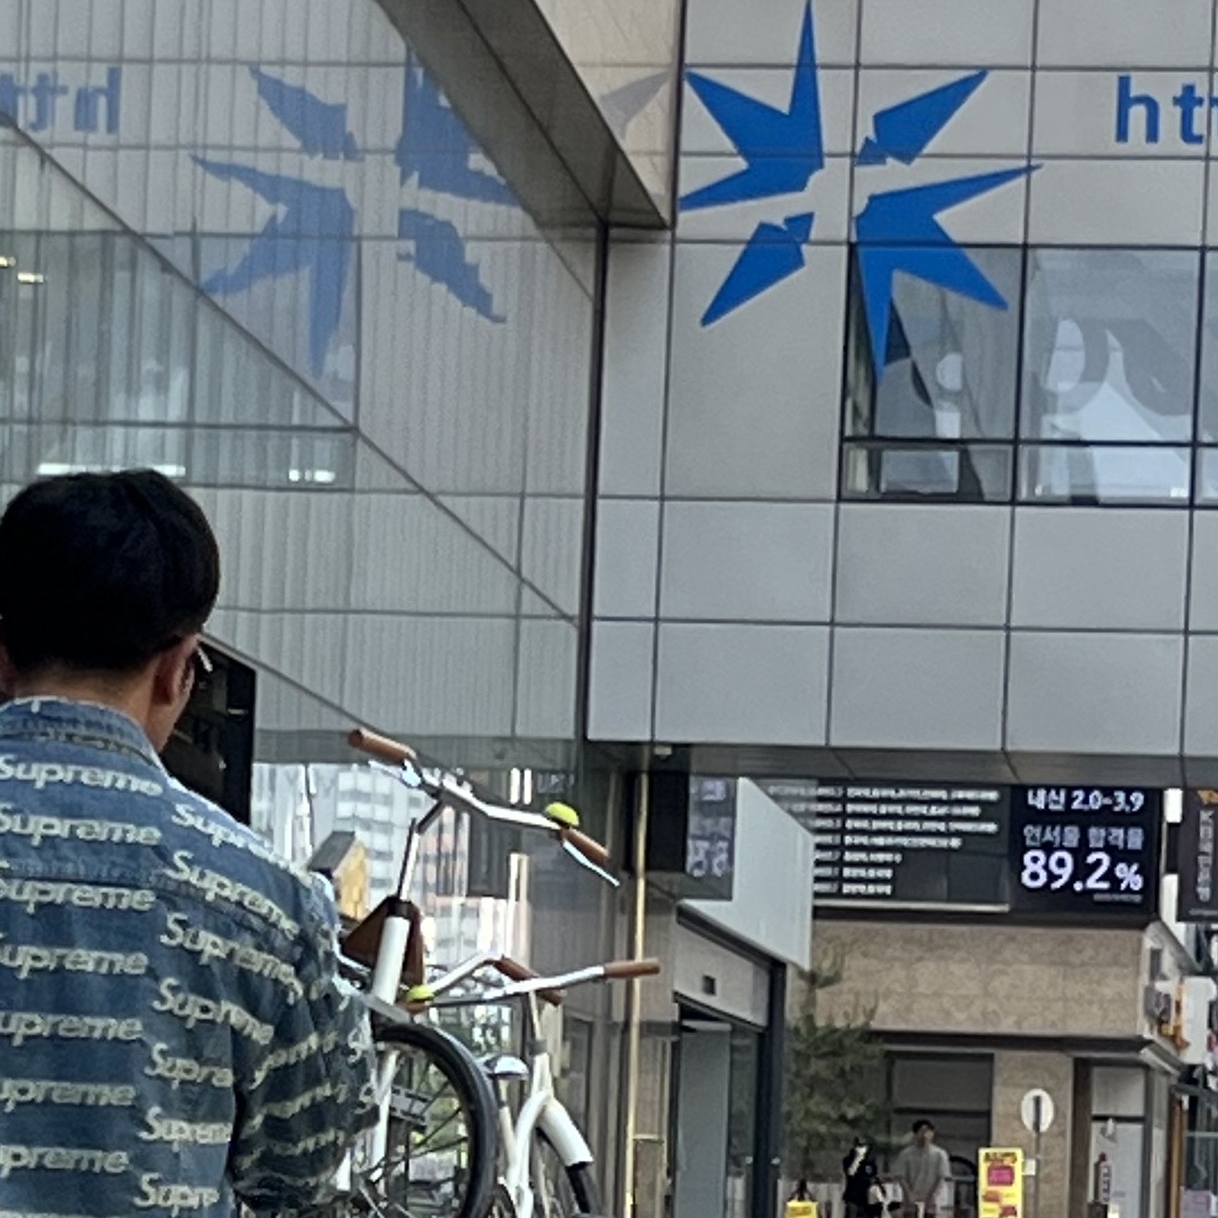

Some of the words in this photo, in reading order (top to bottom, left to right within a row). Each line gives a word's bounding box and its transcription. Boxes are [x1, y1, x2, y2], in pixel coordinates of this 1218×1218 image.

[1115, 75, 1218, 144] ht
[1027, 788, 1066, 811] 내신
[1020, 849, 1145, 892] 89.2%
[143, 1043, 234, 1090] Supre
[137, 1105, 234, 1153] Suprem
